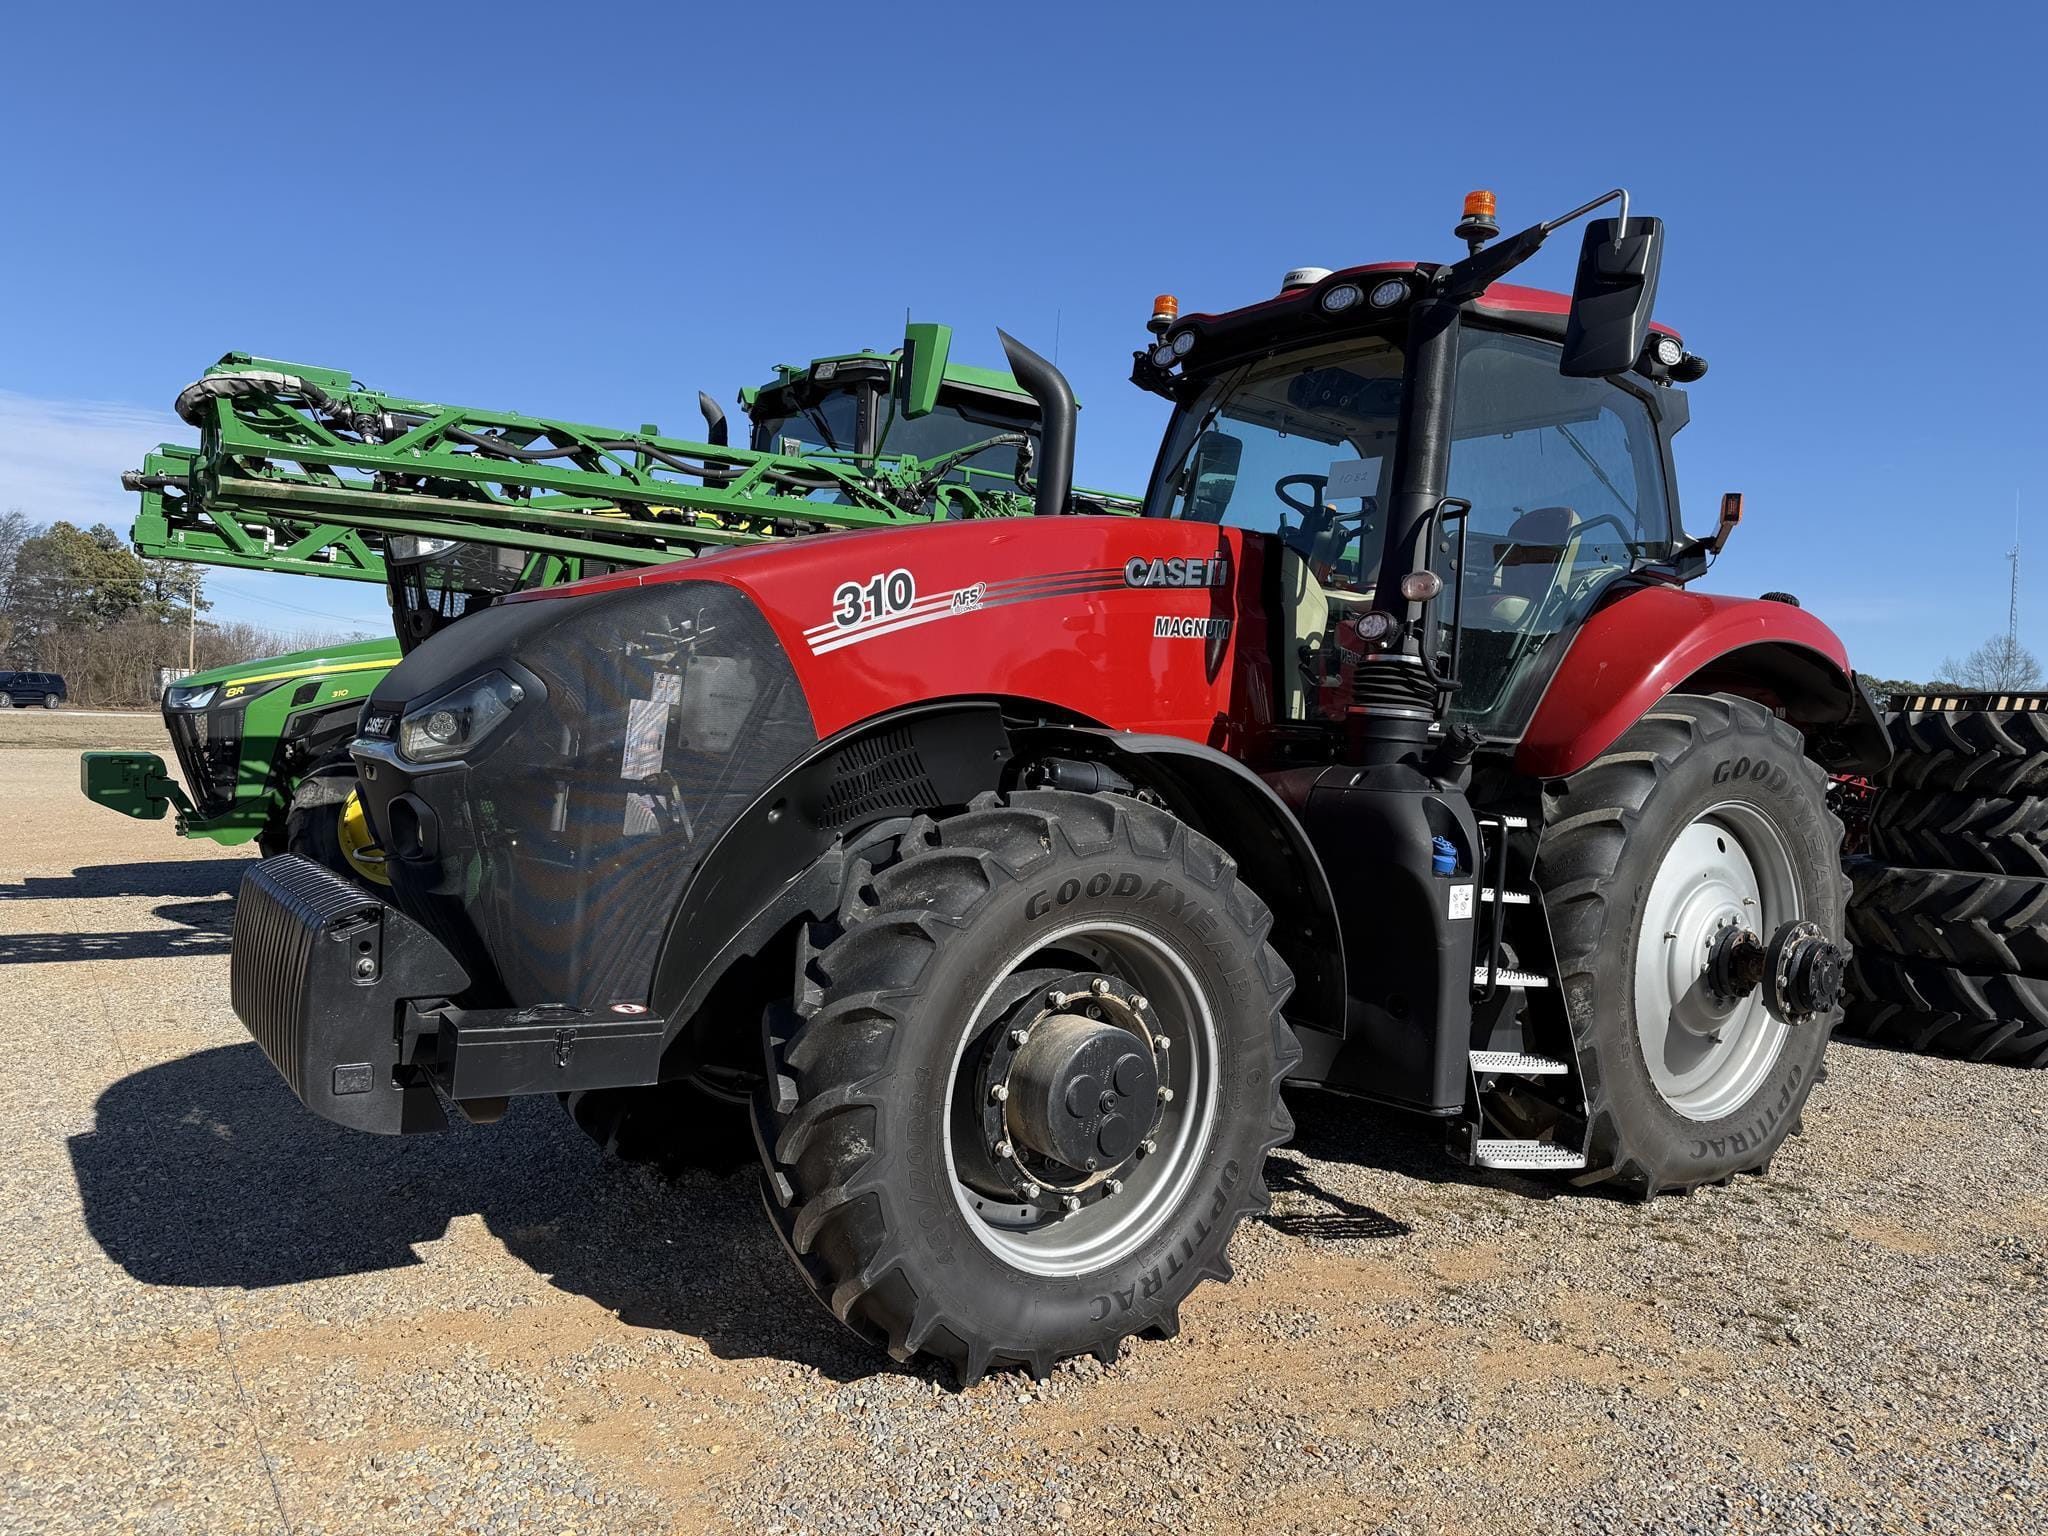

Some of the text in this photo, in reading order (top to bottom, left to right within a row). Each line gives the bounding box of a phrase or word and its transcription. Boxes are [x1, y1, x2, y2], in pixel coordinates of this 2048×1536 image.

[1124, 557, 1204, 588] CASE
[833, 569, 916, 629] 310
[952, 588, 979, 607] AFS
[1153, 616, 1230, 639] MAGNUM
[225, 686, 245, 698] 8R
[331, 689, 349, 698] 310
[1713, 756, 1834, 929] GOODYEAR
[1025, 872, 1252, 1004] GOODYEAR
[1689, 1064, 1802, 1159] OPTITRAC
[1088, 1159, 1240, 1322] OPTITRAC
